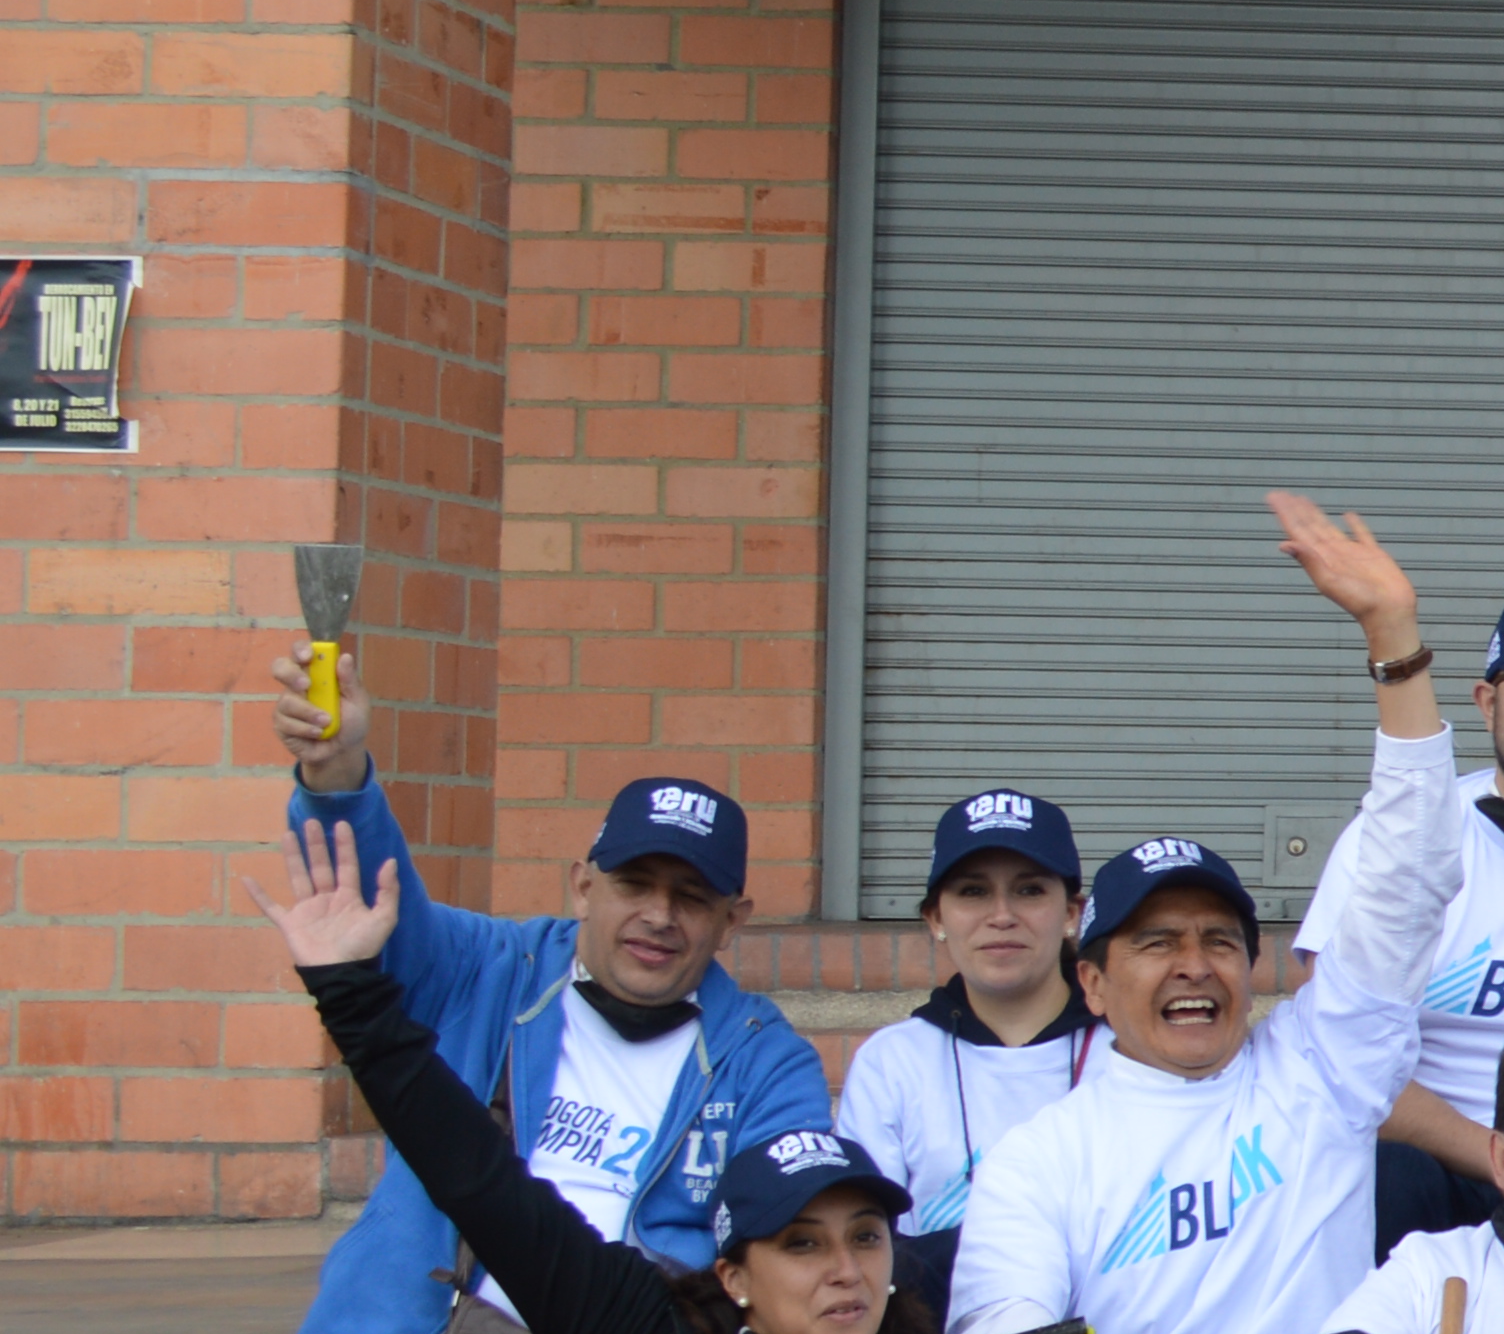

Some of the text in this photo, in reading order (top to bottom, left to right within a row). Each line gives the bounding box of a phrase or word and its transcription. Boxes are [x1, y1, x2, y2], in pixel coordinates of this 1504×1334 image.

[547, 1095, 616, 1138] OGOTÁ
[540, 1121, 605, 1167] MPIA
[692, 1189, 710, 1203] BY
